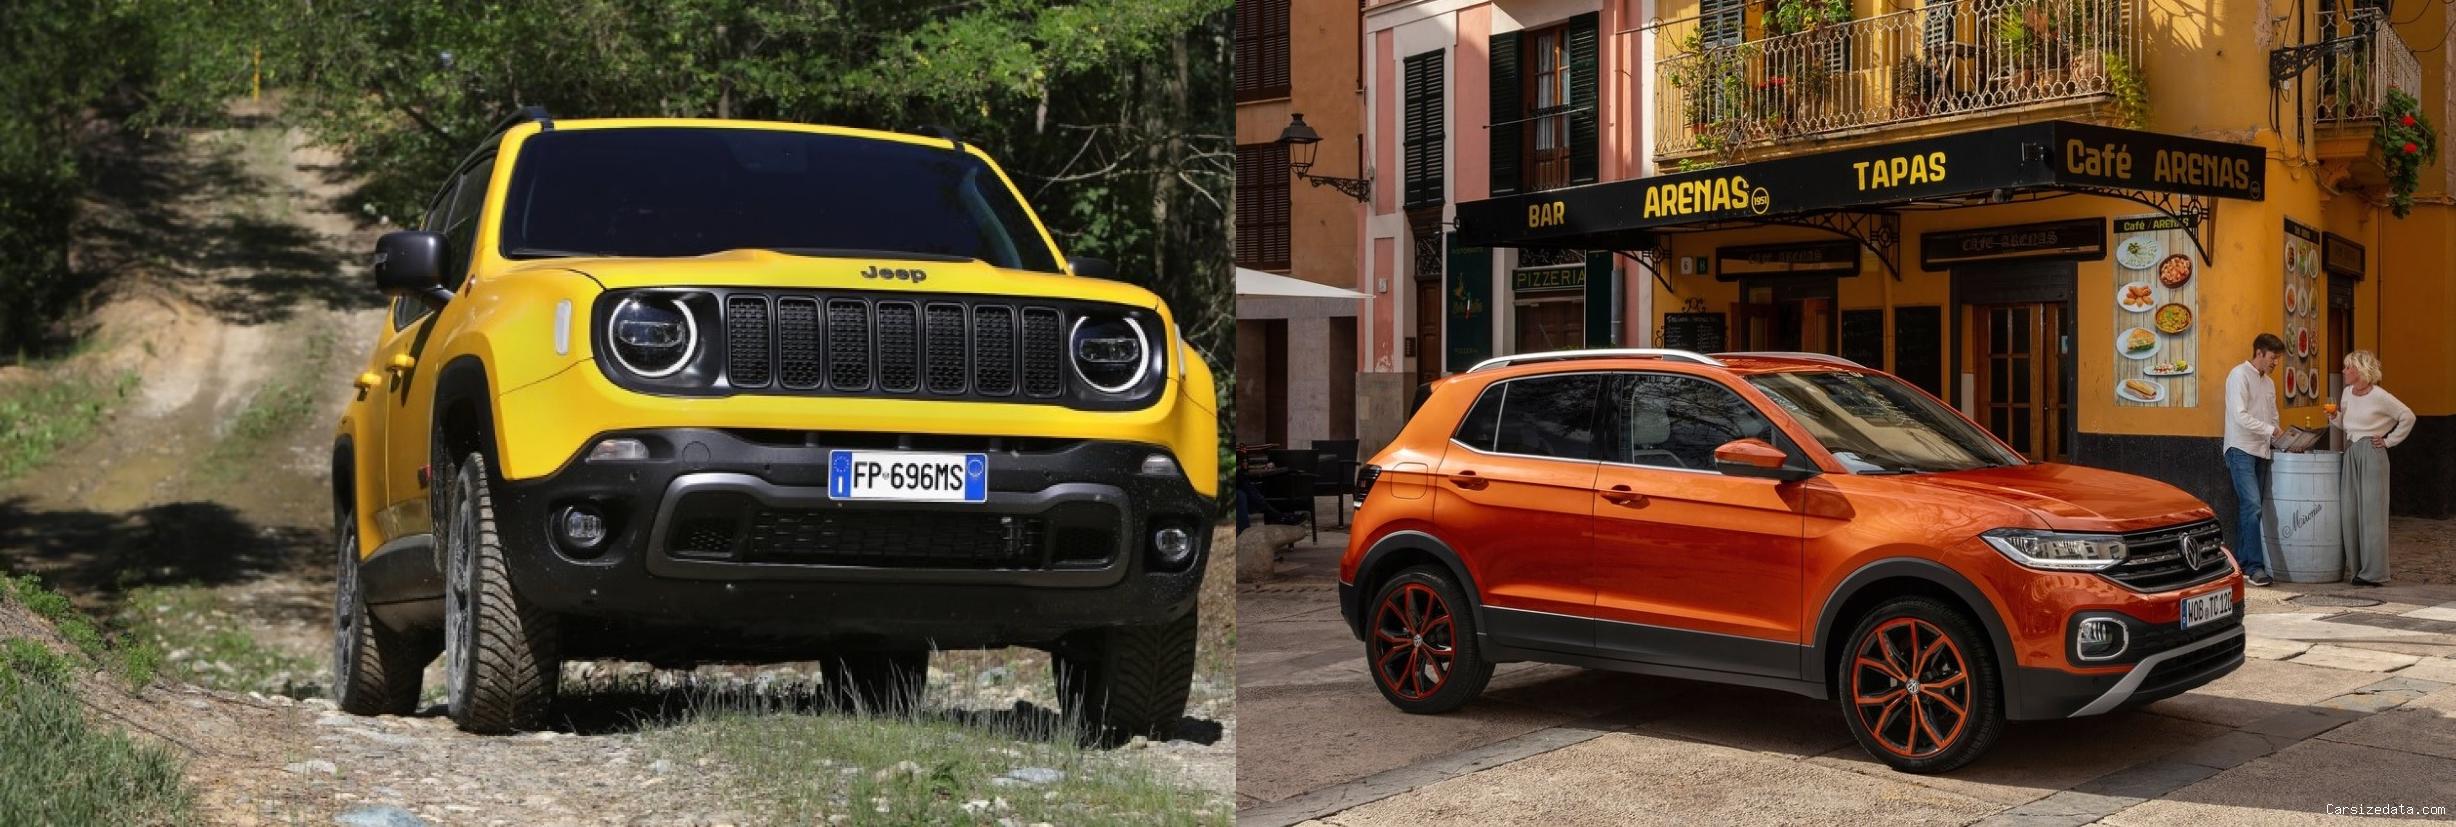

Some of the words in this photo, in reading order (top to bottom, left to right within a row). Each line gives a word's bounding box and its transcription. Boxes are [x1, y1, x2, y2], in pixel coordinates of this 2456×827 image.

[1853, 151, 1946, 191] TAPAS
[2066, 138, 2132, 180] Café
[2153, 148, 2250, 191] ARENAS
[1643, 175, 1749, 219] ARENAS
[1528, 201, 1565, 228] BAR
[2153, 217, 2189, 229] ARENS
[860, 265, 926, 283] Jeep
[1518, 270, 1585, 287] PIZZERIA
[854, 461, 882, 489] FP
[891, 462, 964, 491] 696MS
